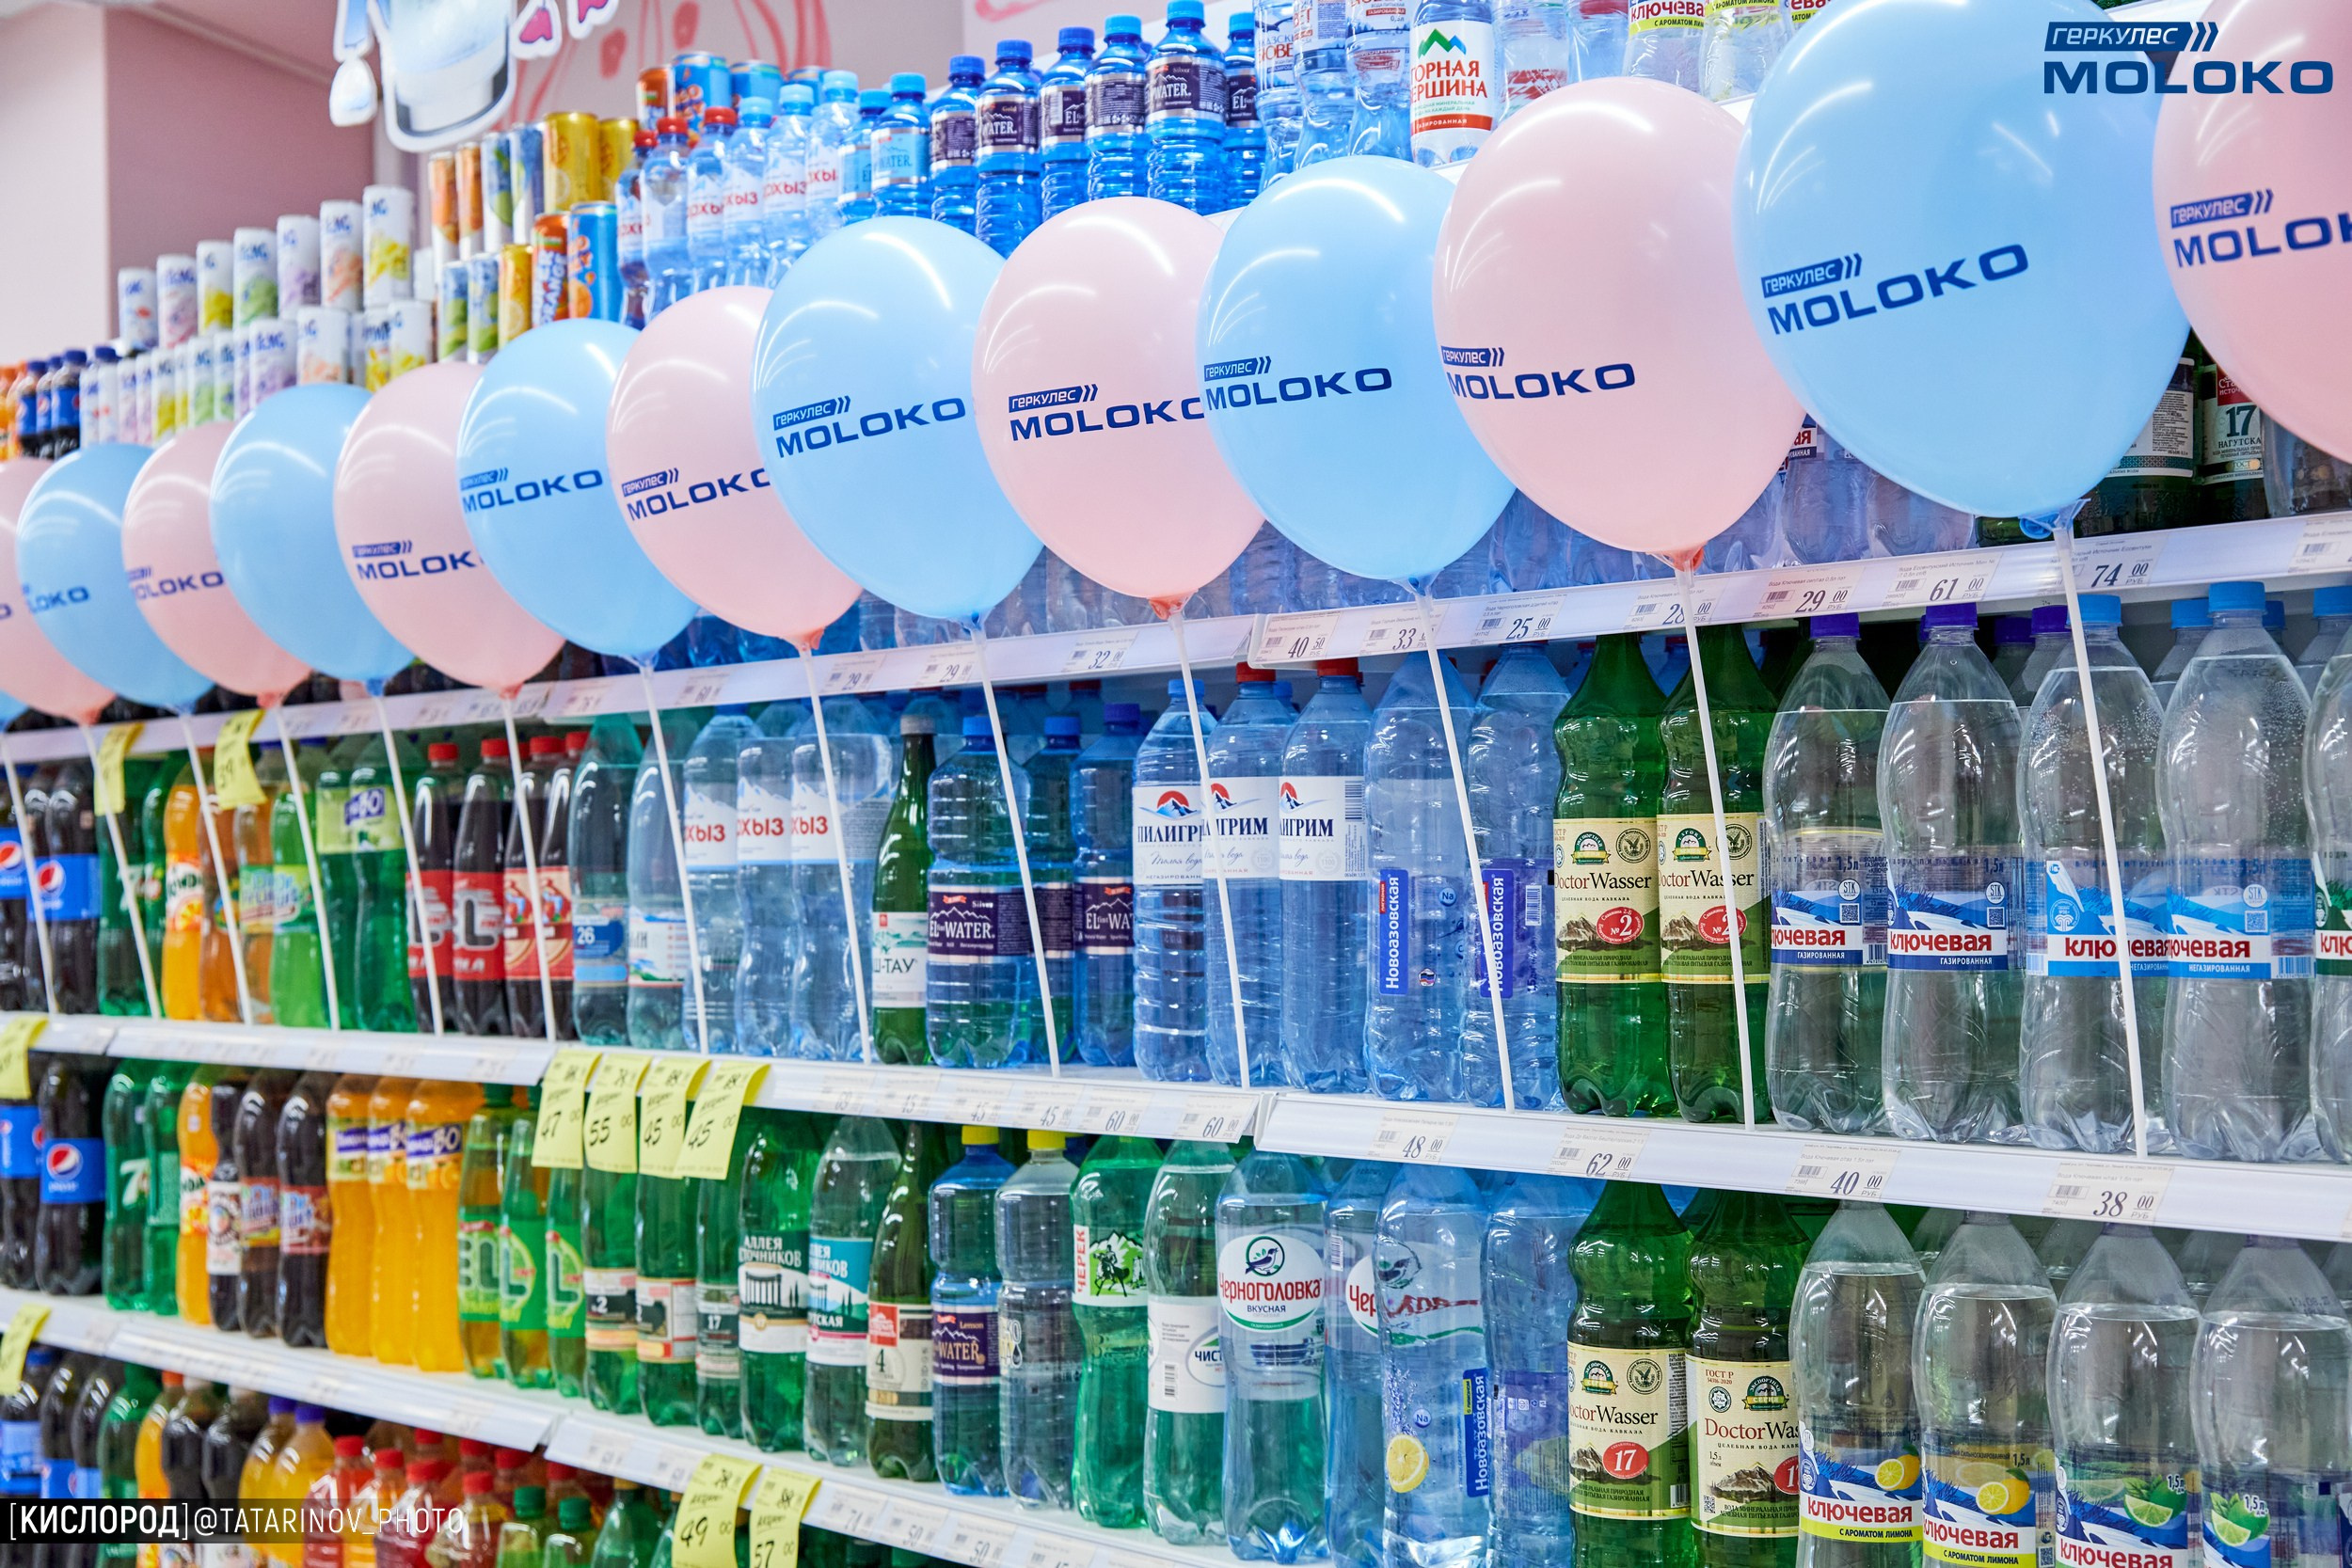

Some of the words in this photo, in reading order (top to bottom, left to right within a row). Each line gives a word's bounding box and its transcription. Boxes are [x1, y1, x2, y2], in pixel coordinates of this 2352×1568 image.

[1411, 80, 1488, 103] ЕРШИНА
[1768, 245, 2028, 335] MOLOKO
[1206, 368, 1392, 411] MOLOKO
[1447, 363, 1635, 400] MOLOKO
[775, 397, 966, 458] MOLOKO
[2226, 404, 2257, 437] 17
[2218, 436, 2262, 449] НАГУТСКА
[462, 469, 603, 515] MOLOKO
[357, 550, 485, 580] MOLOK
[2090, 563, 2123, 588] 74
[2132, 563, 2149, 576] 00
[1930, 578, 1959, 601] 61
[1968, 578, 1984, 590] 00
[1697, 602, 1711, 613] 00
[1795, 590, 1826, 613] 29
[1833, 590, 1848, 602] 00
[1392, 628, 1416, 650] 33
[1506, 617, 1534, 639] 25
[1537, 618, 1550, 628] 00
[1288, 637, 1309, 657] 40
[1313, 637, 1326, 649] 50
[1089, 650, 1111, 669] 32
[1441, 892, 1454, 900] Na
[1843, 882, 1857, 894] STK
[1990, 886, 2002, 896] STK
[2249, 887, 2263, 898] STK
[1386, 877, 1399, 990] Новоазовская
[1620, 916, 1632, 937] 2
[1940, 957, 1993, 965] ГАЗИРОВАННАЯ
[2189, 964, 2250, 973] НЕГАЗИРОВАННАЯ
[1041, 1106, 1058, 1127] 45
[1105, 1111, 1126, 1132] 60
[1202, 1117, 1224, 1138] 60
[590, 1117, 611, 1148] 55
[1403, 1135, 1426, 1158] 48
[1431, 1139, 1443, 1151] 00
[1586, 1153, 1613, 1177] 62
[1618, 1157, 1631, 1169] 00
[1830, 1171, 1860, 1195] 40
[1867, 1175, 1883, 1188] 00
[2093, 1191, 2127, 1217] 38
[2137, 1196, 2153, 1209] 00
[744, 1235, 783, 1250] АЛЛЕЯ
[1076, 1229, 1085, 1292] ЧЕРЕК
[1247, 1305, 1286, 1313] ВКУСНАЯ
[876, 1349, 885, 1372] 4
[1706, 1369, 1726, 1377] ГОСТ
[1475, 1375, 1488, 1491] Новоазовская
[1613, 1449, 1636, 1472] 17
[681, 1516, 707, 1547] 49
[1845, 1528, 1883, 1538] АРОМАТОМ
[1885, 1528, 1913, 1538] ЛИМОНА
[1948, 1551, 1985, 1562] АРОМАТОМ
[1987, 1555, 2019, 1564] ЛИМОНА
